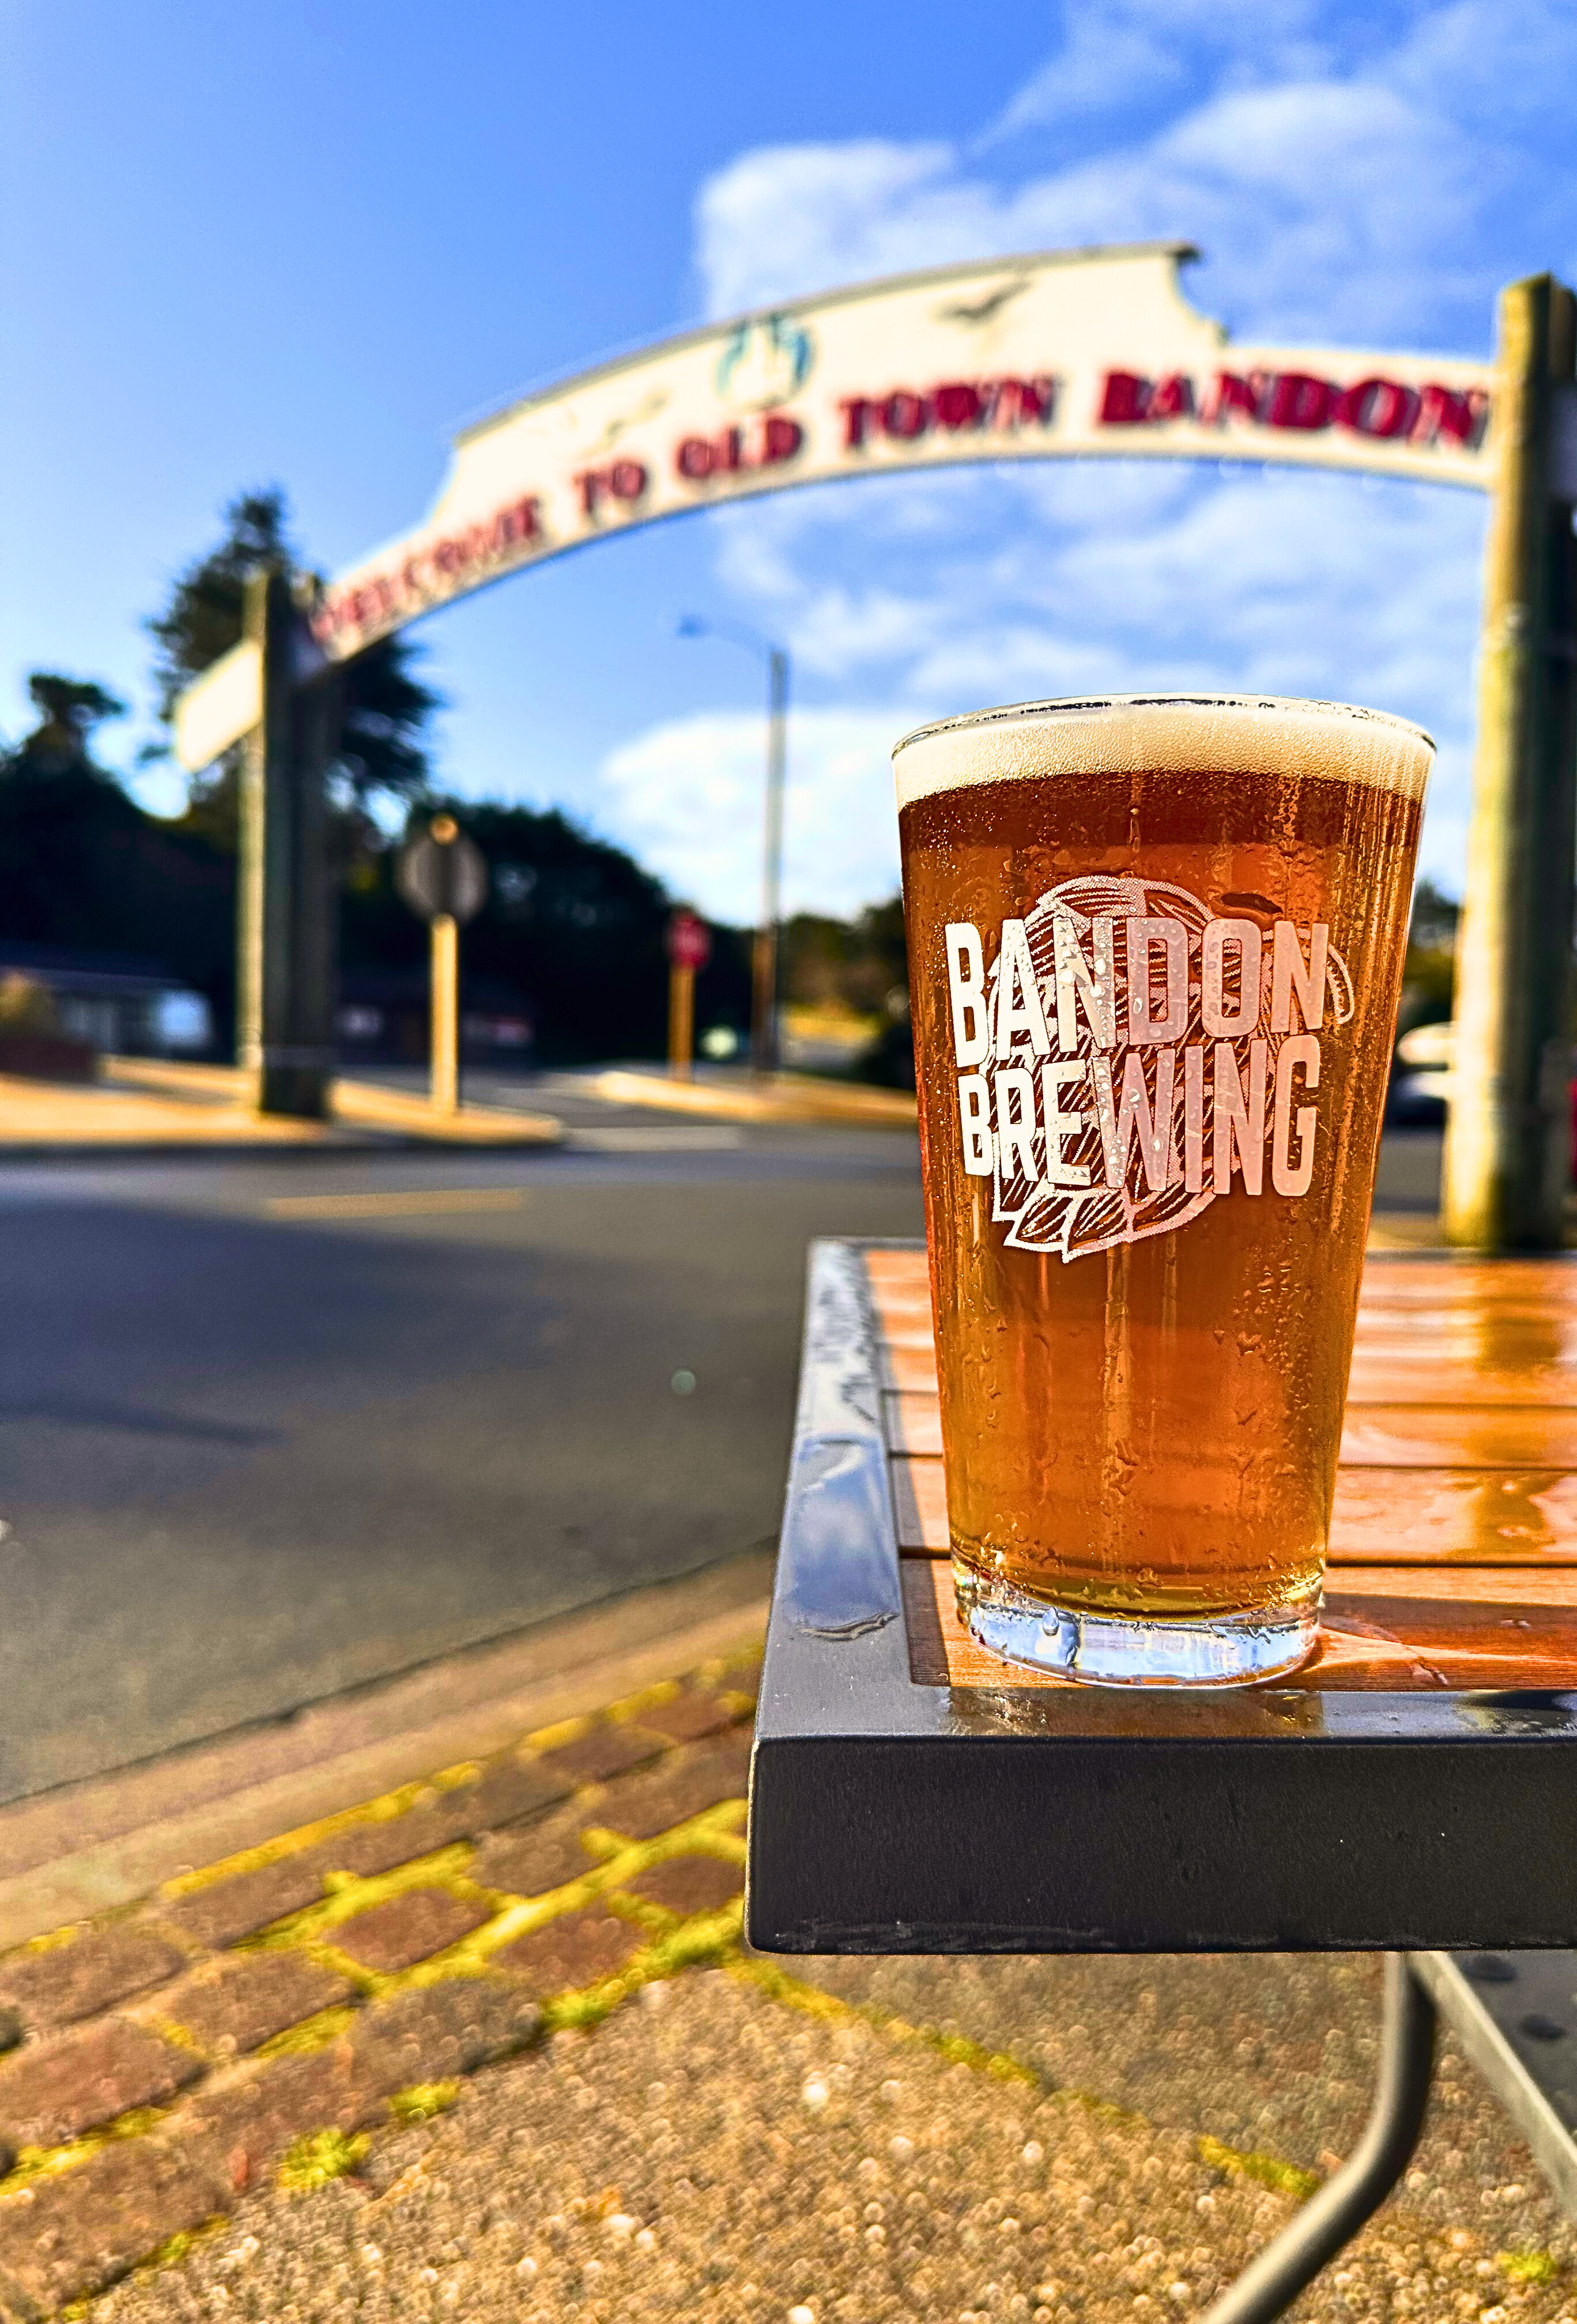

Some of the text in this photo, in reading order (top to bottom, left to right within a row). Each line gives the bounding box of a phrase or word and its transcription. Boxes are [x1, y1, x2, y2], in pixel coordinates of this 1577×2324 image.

[575, 461, 648, 515] TO
[676, 415, 802, 478] OLD
[839, 375, 1055, 447] TOWN
[1100, 370, 1490, 451] BANDON
[945, 918, 1329, 1067] BANDON
[958, 1035, 1321, 1197] BREWING
